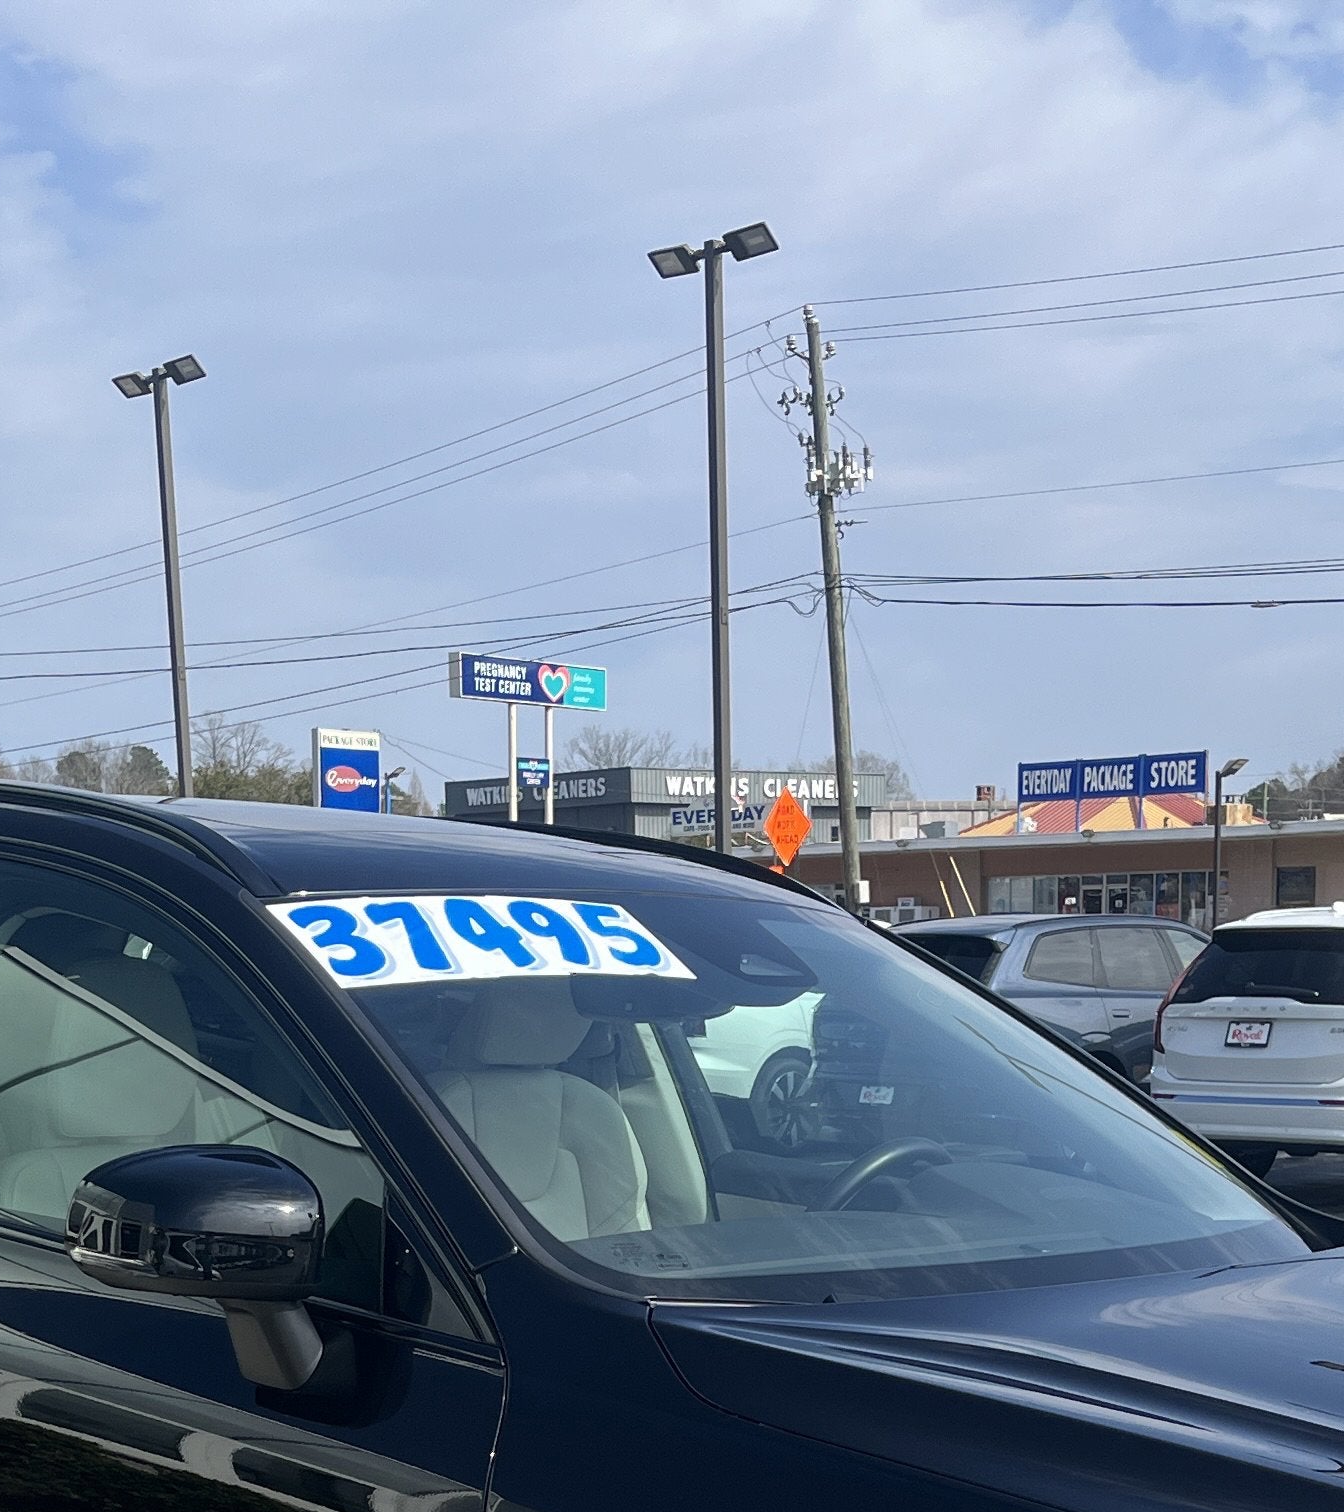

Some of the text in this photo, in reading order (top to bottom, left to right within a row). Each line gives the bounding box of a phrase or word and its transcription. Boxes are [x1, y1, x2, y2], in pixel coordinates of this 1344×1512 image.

[474, 661, 527, 680] PREGNANCY
[474, 677, 532, 696] TEST CENTER
[322, 735, 377, 747] PACKAGE STORE
[666, 776, 750, 797] WATKS
[1022, 759, 1198, 796] EVERYDAY PACKAGE STORE
[466, 785, 523, 807] WATKIS
[672, 805, 766, 826] EVERDAY
[777, 805, 795, 815] ROAD
[777, 834, 799, 844] AHEAD
[288, 899, 662, 977] 37495
